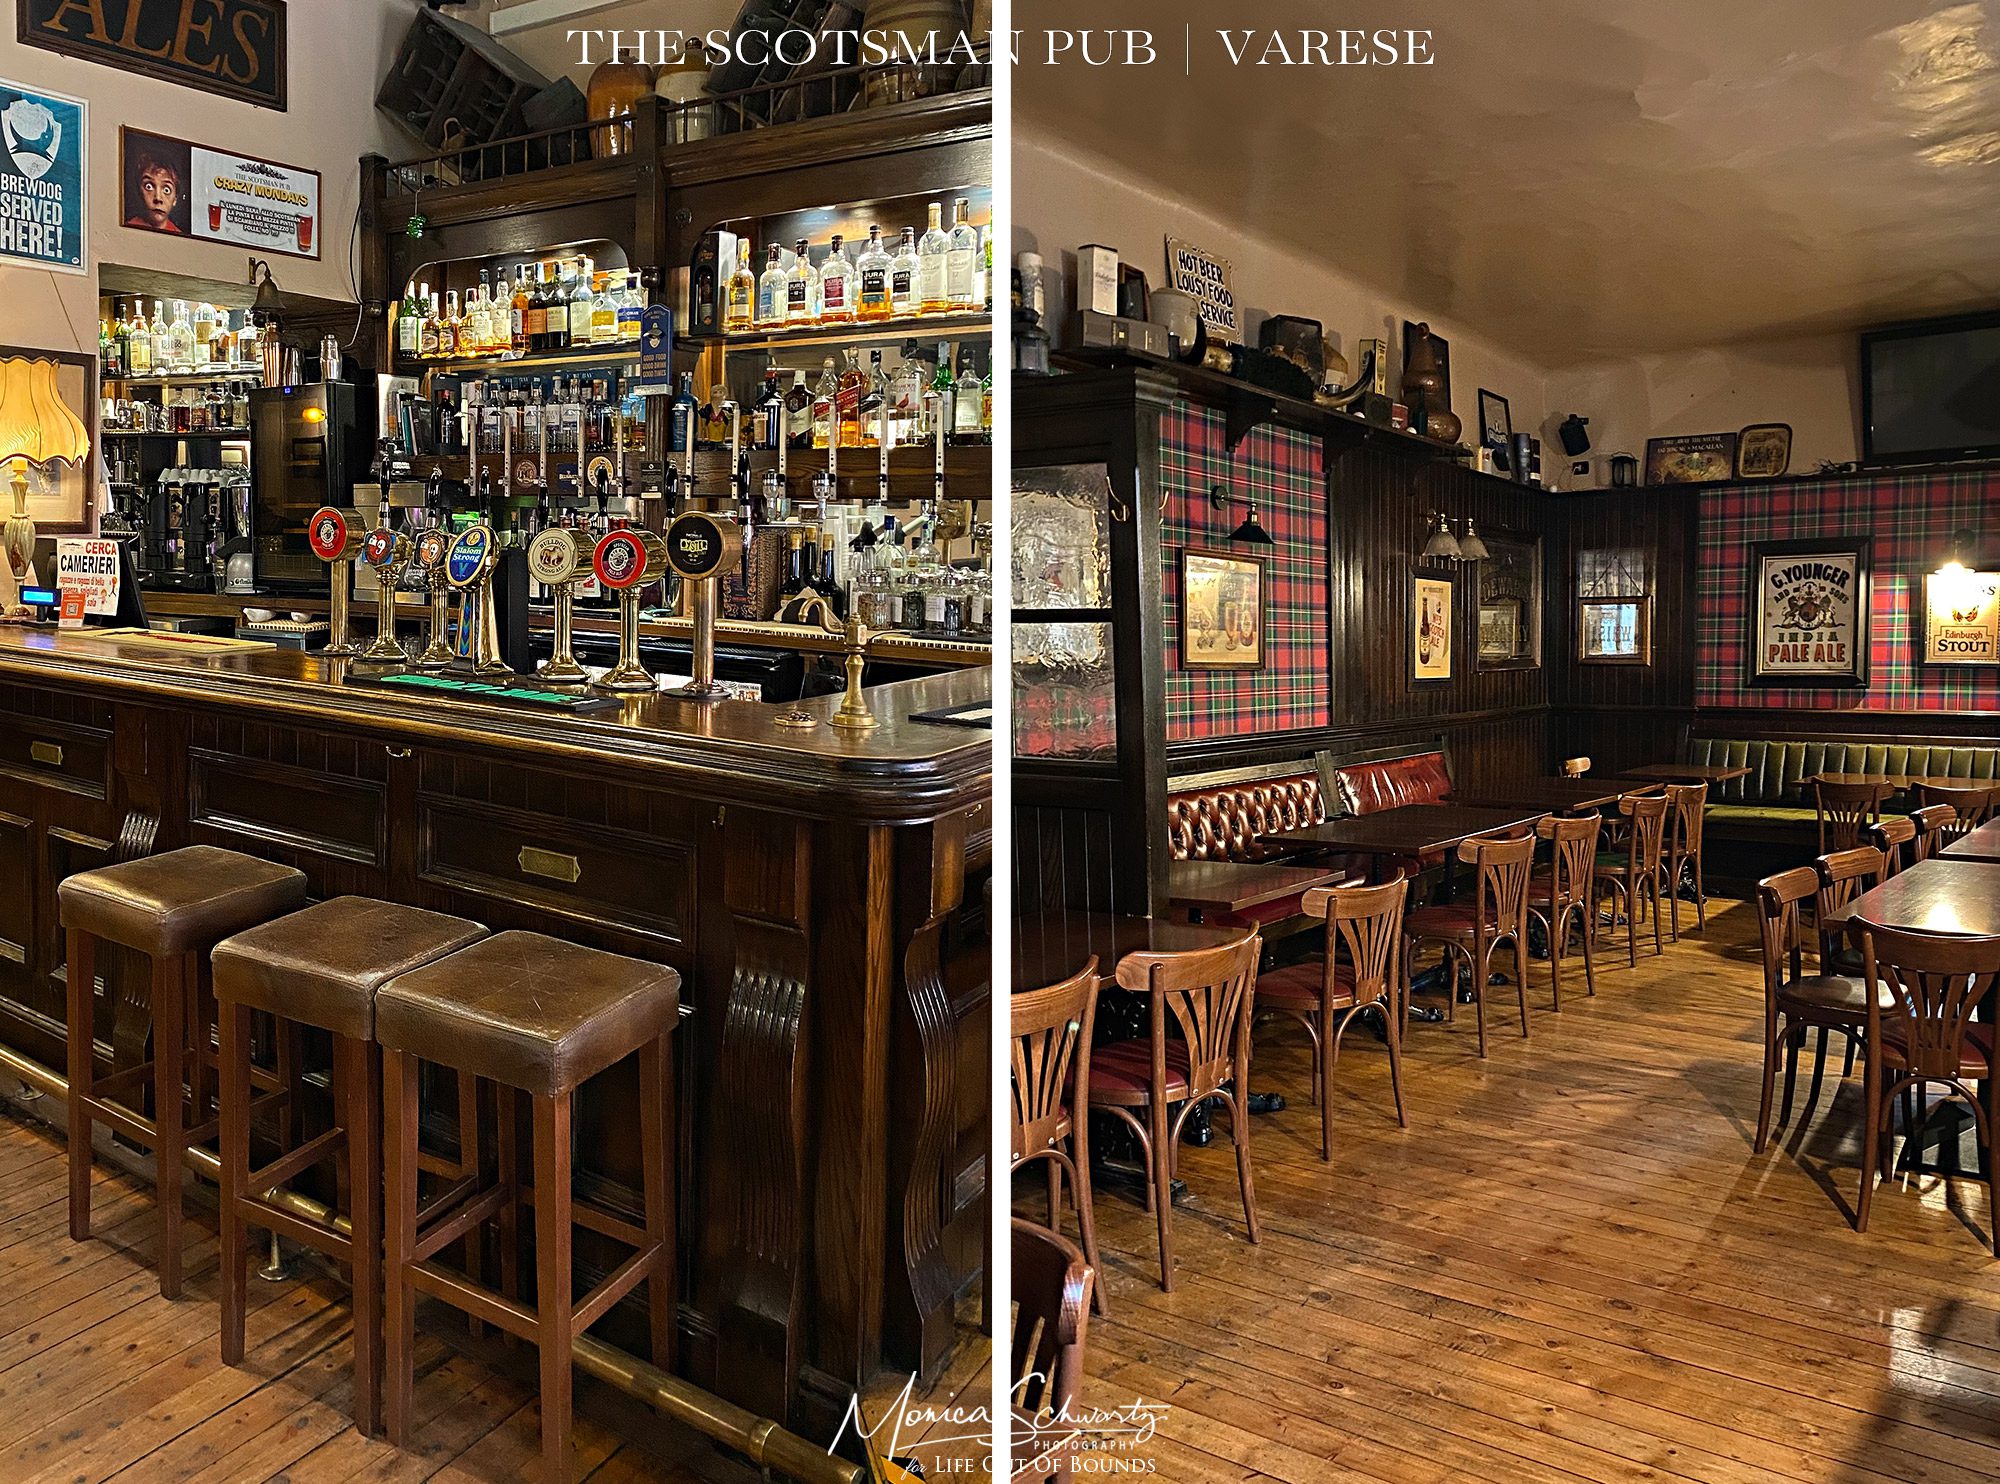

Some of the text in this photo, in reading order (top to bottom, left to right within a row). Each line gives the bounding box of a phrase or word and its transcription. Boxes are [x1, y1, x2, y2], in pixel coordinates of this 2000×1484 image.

[41, 0, 269, 84] ALES
[1, 172, 62, 201] BREWDOG
[247, 174, 279, 187] SCOTSMAN
[214, 176, 308, 206] CRAZY MONDAYS
[1, 193, 62, 226] SERVED
[1, 217, 62, 259] HERE!
[1178, 249, 1224, 286] HOT BEER
[864, 271, 885, 280] JURA
[1175, 270, 1234, 308] LOUSY FOOD
[1200, 300, 1235, 329] SERVICE
[643, 353, 666, 362] GOOD FOOD
[643, 370, 654, 378] GOOD
[85, 542, 117, 556] CERCA
[454, 546, 483, 555] Slalom
[539, 539, 567, 550] BULLDOG
[60, 554, 116, 575] CAMERIERI
[452, 553, 481, 563] Strong
[537, 562, 564, 574] STRONG ALE
[95, 577, 104, 586] bella
[1770, 563, 1850, 589] G.YOUNGER
[1773, 588, 1791, 604] AND
[86, 599, 97, 607] sala
[1778, 632, 1839, 642] INDIA
[1945, 630, 1983, 640] Edinburgh
[1938, 639, 1990, 652] STOUT
[1768, 643, 1846, 662] PALE ALE
